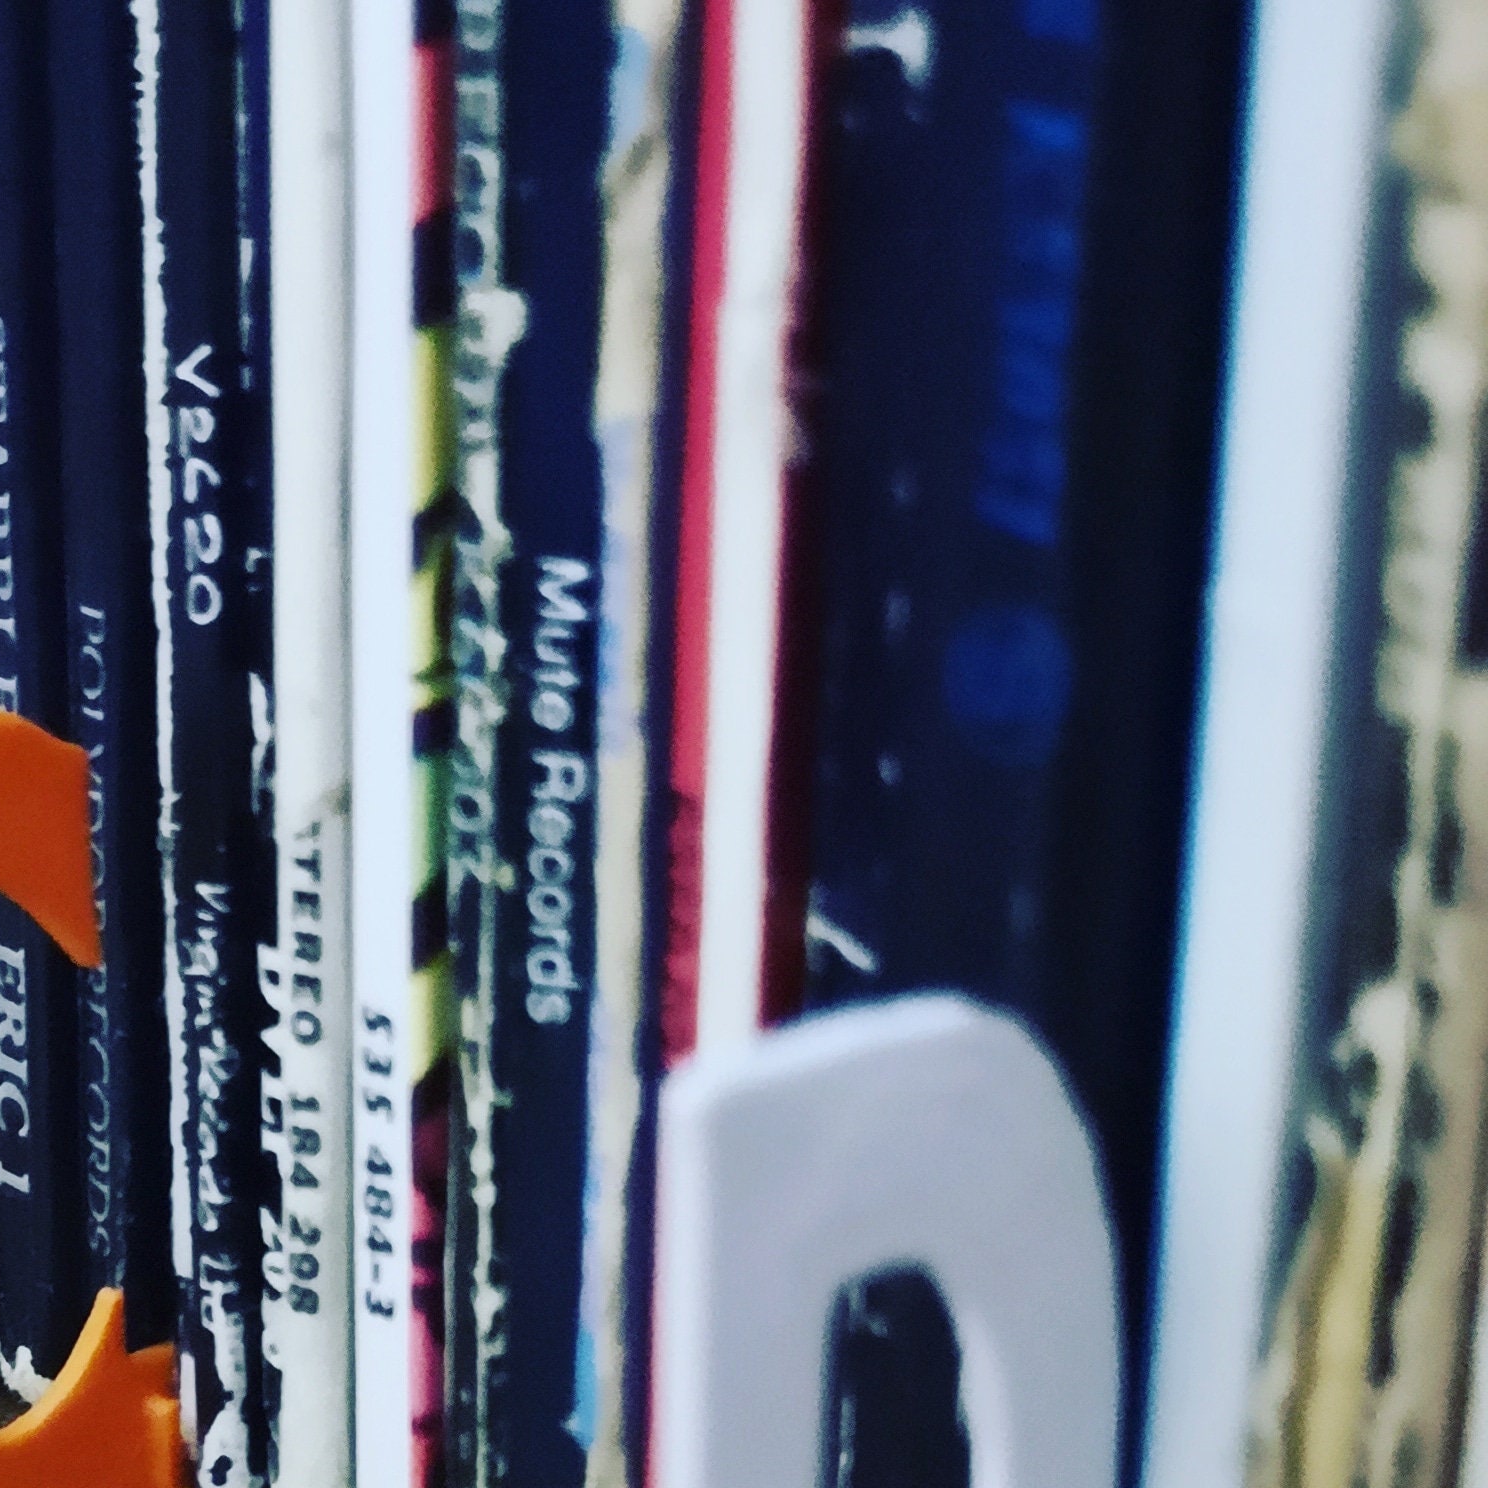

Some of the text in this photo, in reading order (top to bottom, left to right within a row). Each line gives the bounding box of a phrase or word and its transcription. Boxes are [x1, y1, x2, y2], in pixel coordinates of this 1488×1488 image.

[524, 554, 591, 1027] Mute Records
[179, 881, 232, 1029] Virgin
[288, 1093, 322, 1189] 184
[361, 1003, 398, 1322] 535 484-3
